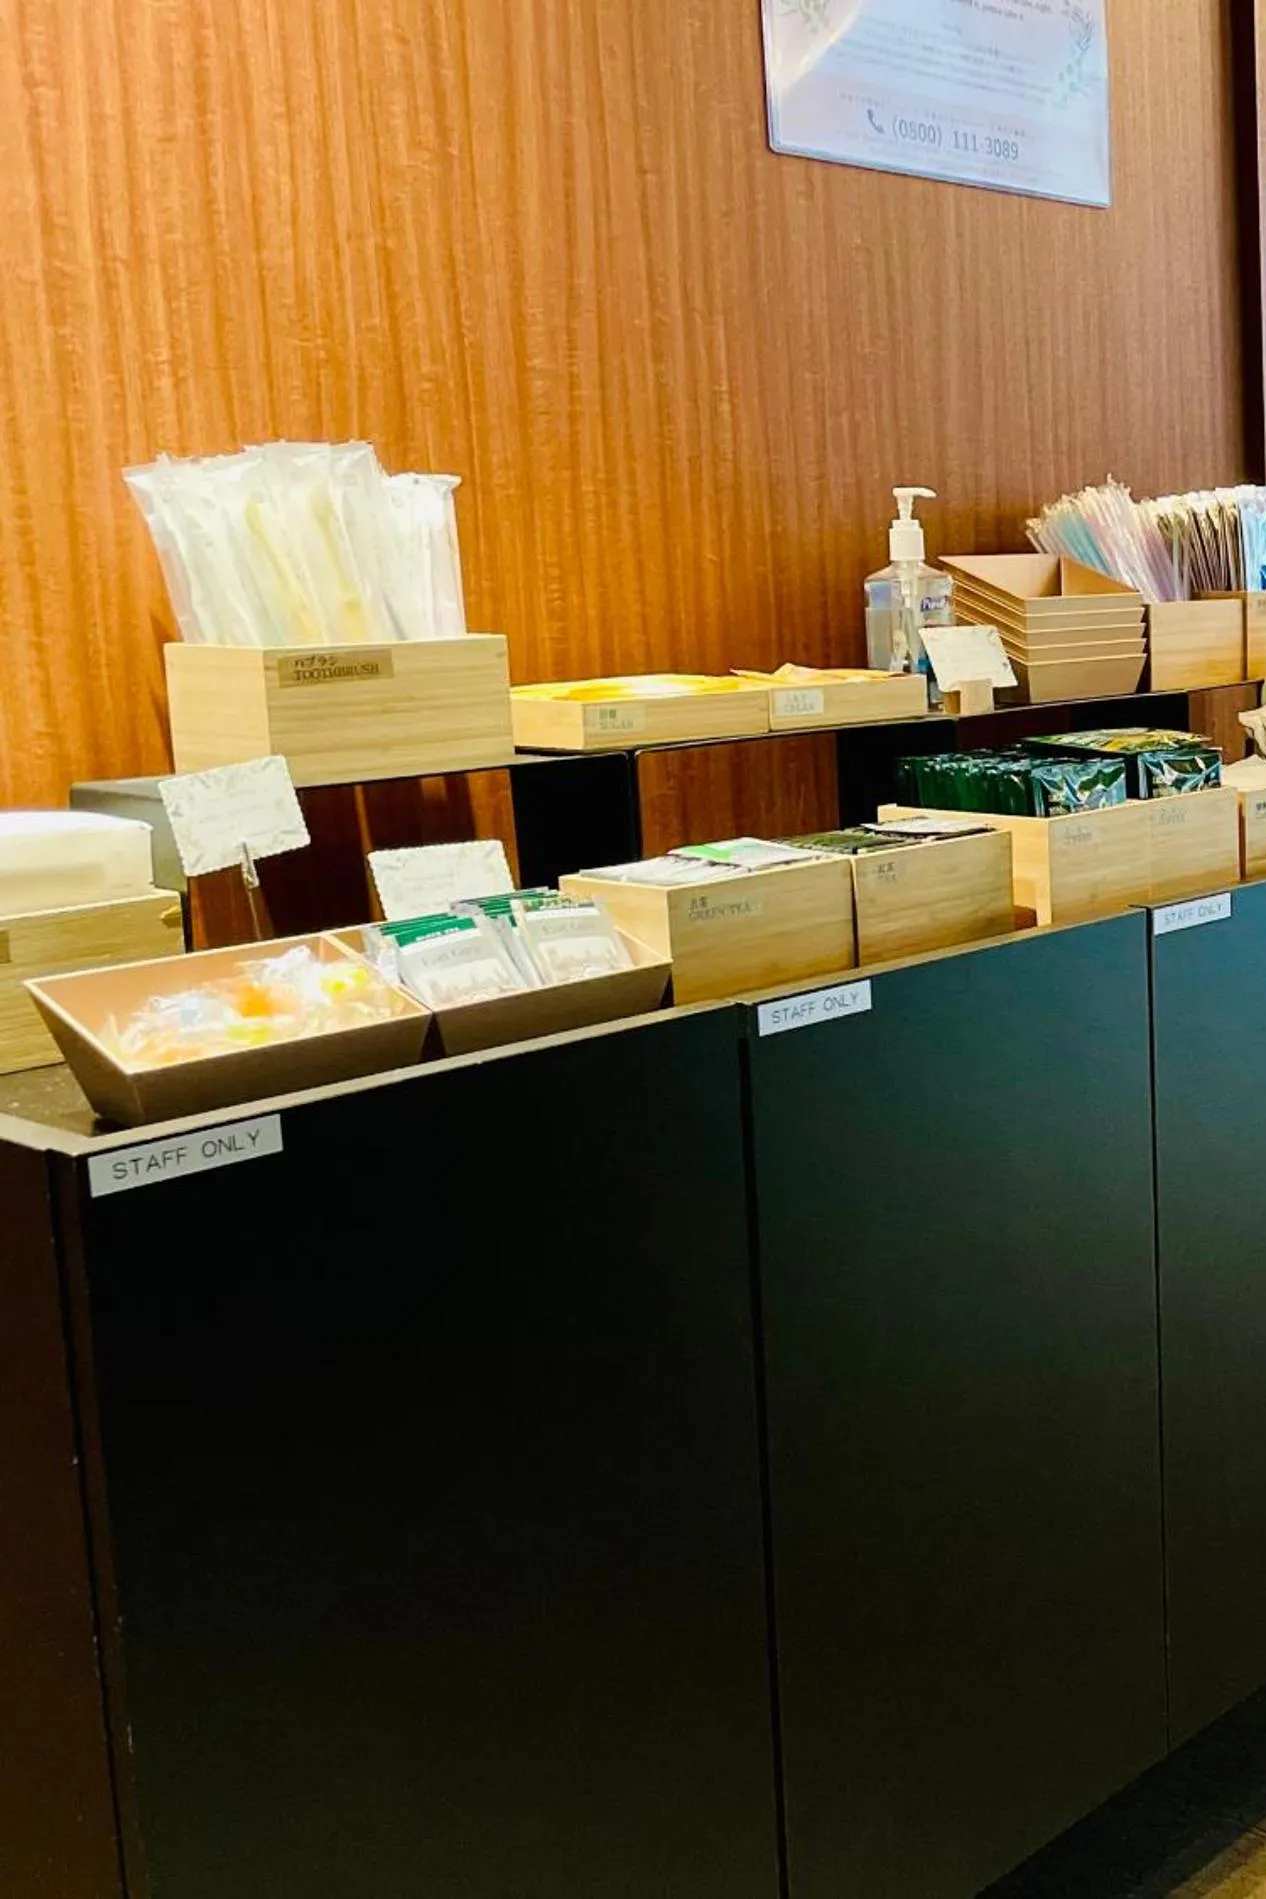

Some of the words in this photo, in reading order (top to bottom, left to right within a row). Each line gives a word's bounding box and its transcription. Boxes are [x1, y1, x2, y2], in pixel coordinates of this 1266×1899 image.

[892, 115, 943, 147] (0800)
[953, 130, 979, 153] 111
[984, 137, 1020, 161] 3089
[294, 663, 380, 681] TOOTHBRUSH
[771, 1001, 817, 1024] STAFF
[823, 991, 859, 1012] ONLY
[111, 1146, 188, 1180] STAFF
[201, 1129, 260, 1158] ONLY
